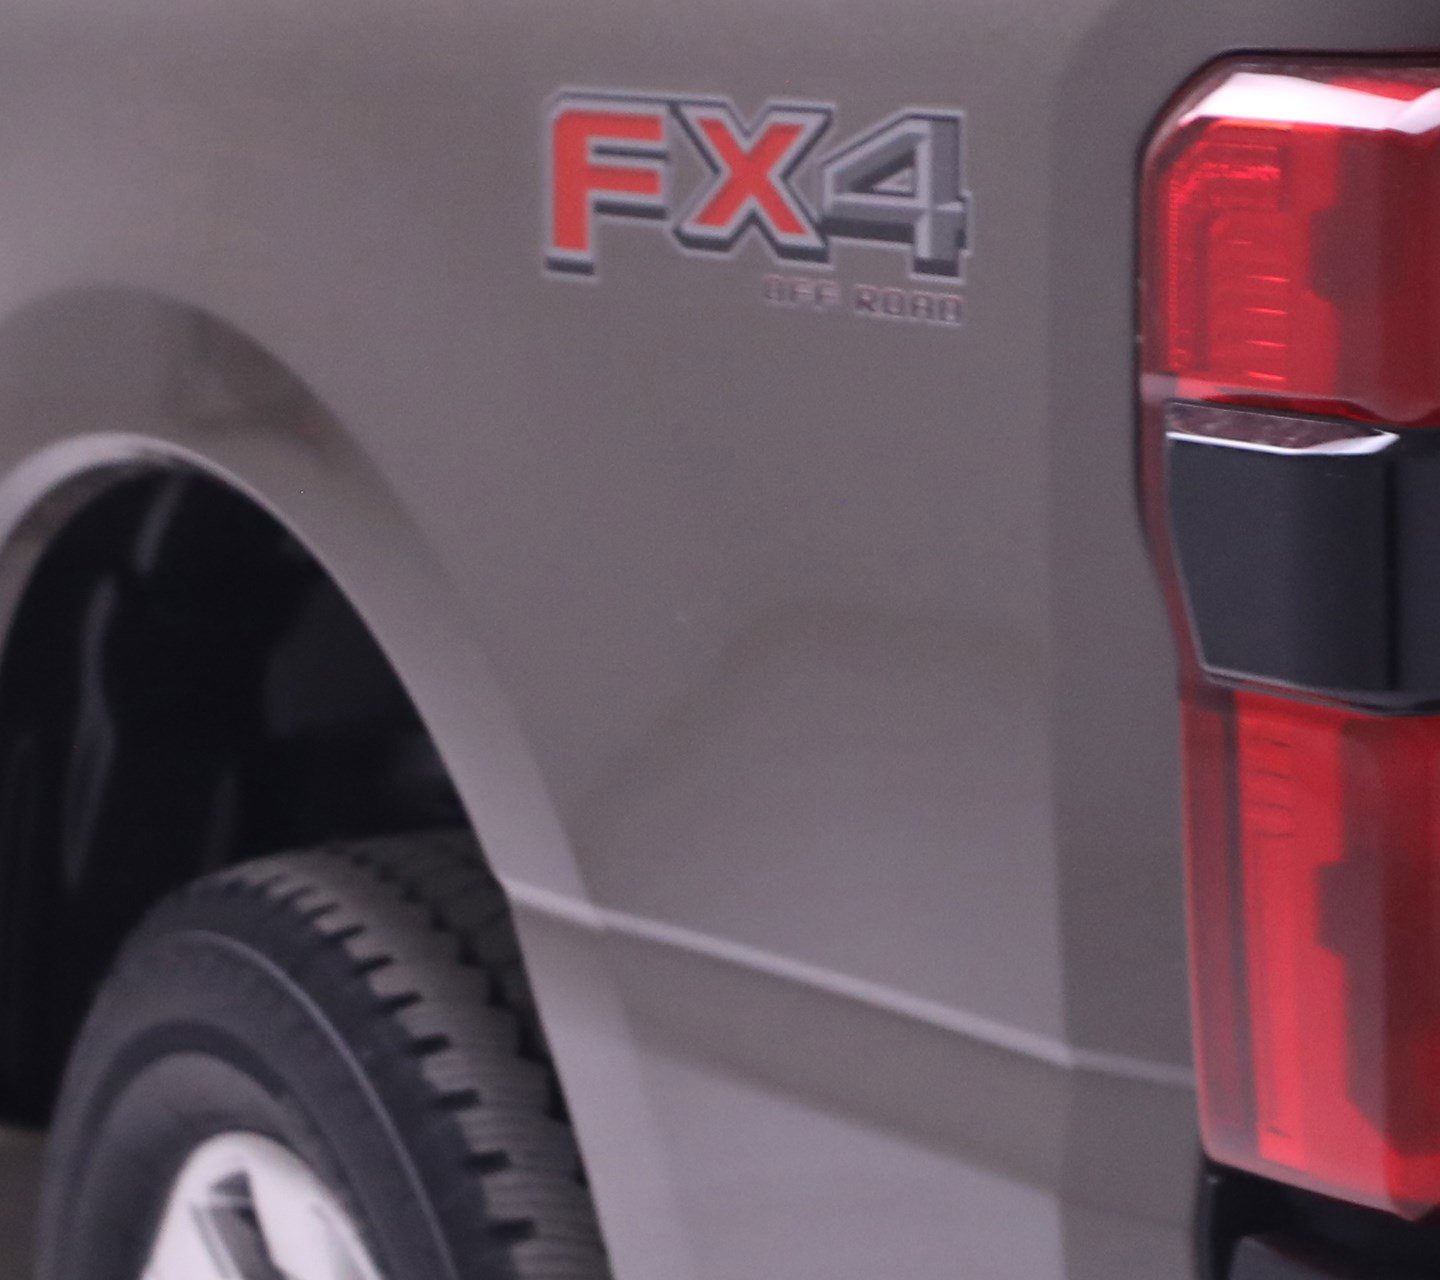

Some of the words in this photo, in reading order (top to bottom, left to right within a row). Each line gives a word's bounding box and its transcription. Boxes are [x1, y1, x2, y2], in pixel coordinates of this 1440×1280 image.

[544, 89, 973, 282] FX4
[763, 275, 839, 310] OFF
[853, 284, 965, 327] ROAD
